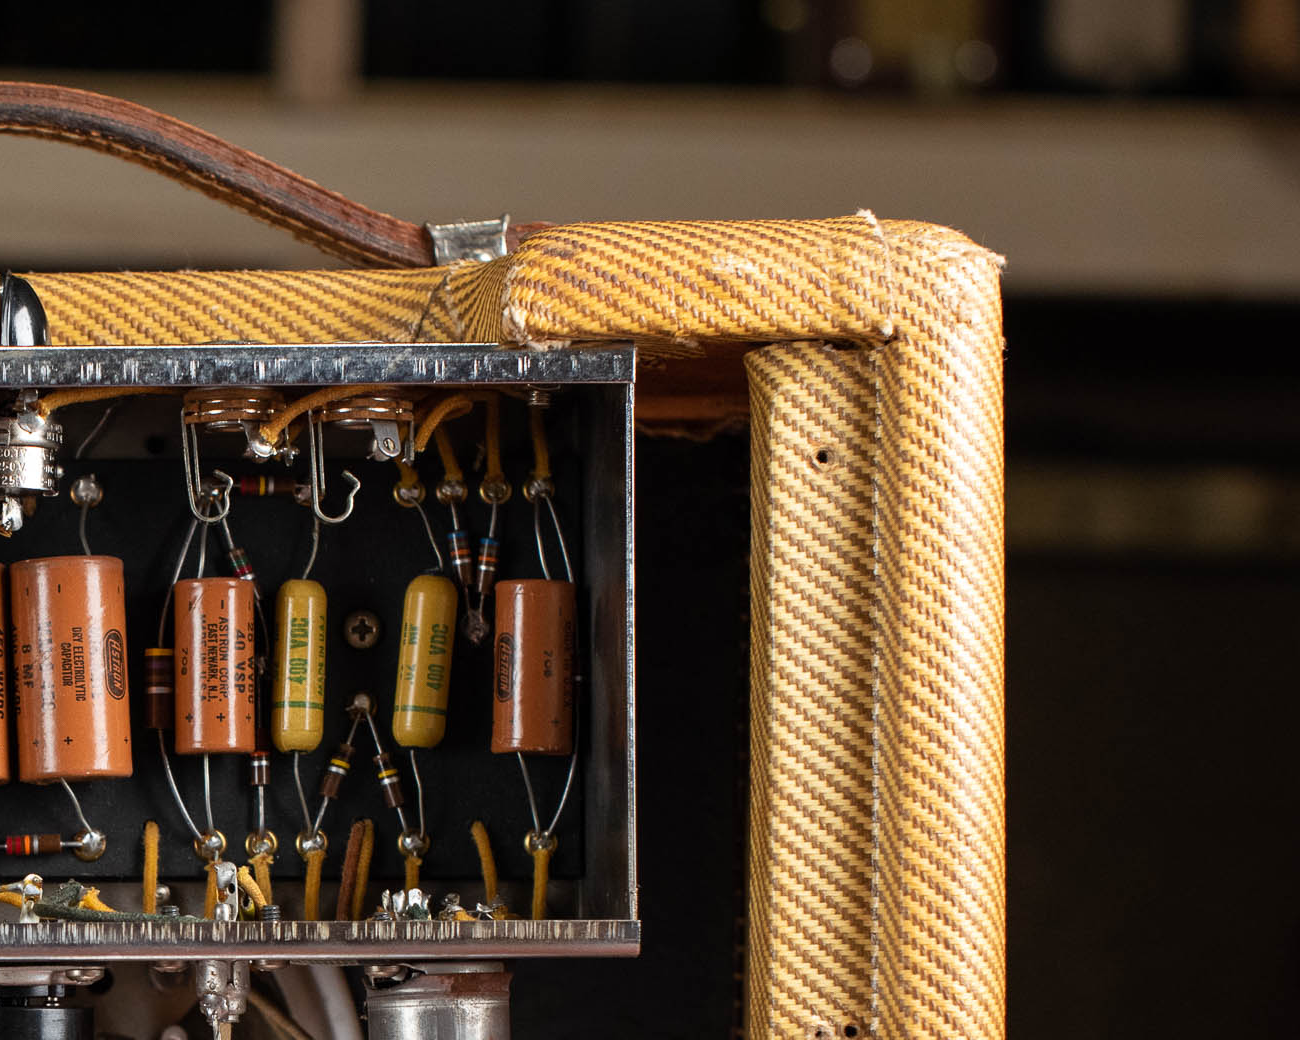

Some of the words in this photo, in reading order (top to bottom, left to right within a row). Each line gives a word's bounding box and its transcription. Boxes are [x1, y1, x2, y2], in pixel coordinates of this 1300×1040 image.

[71, 627, 83, 643] DRY
[208, 623, 218, 643] EAST
[219, 616, 229, 661] ASTRON
[235, 629, 246, 651] 40
[289, 617, 309, 649] VDC
[428, 623, 449, 656] VDC
[61, 642, 74, 687] CAPACITOR
[73, 646, 87, 702] ELECTROLYTIC
[207, 645, 218, 682] NEWARK,
[234, 661, 246, 694] VSP
[288, 658, 308, 685] 400
[427, 664, 445, 691] 400
[219, 667, 229, 702] CORP.
